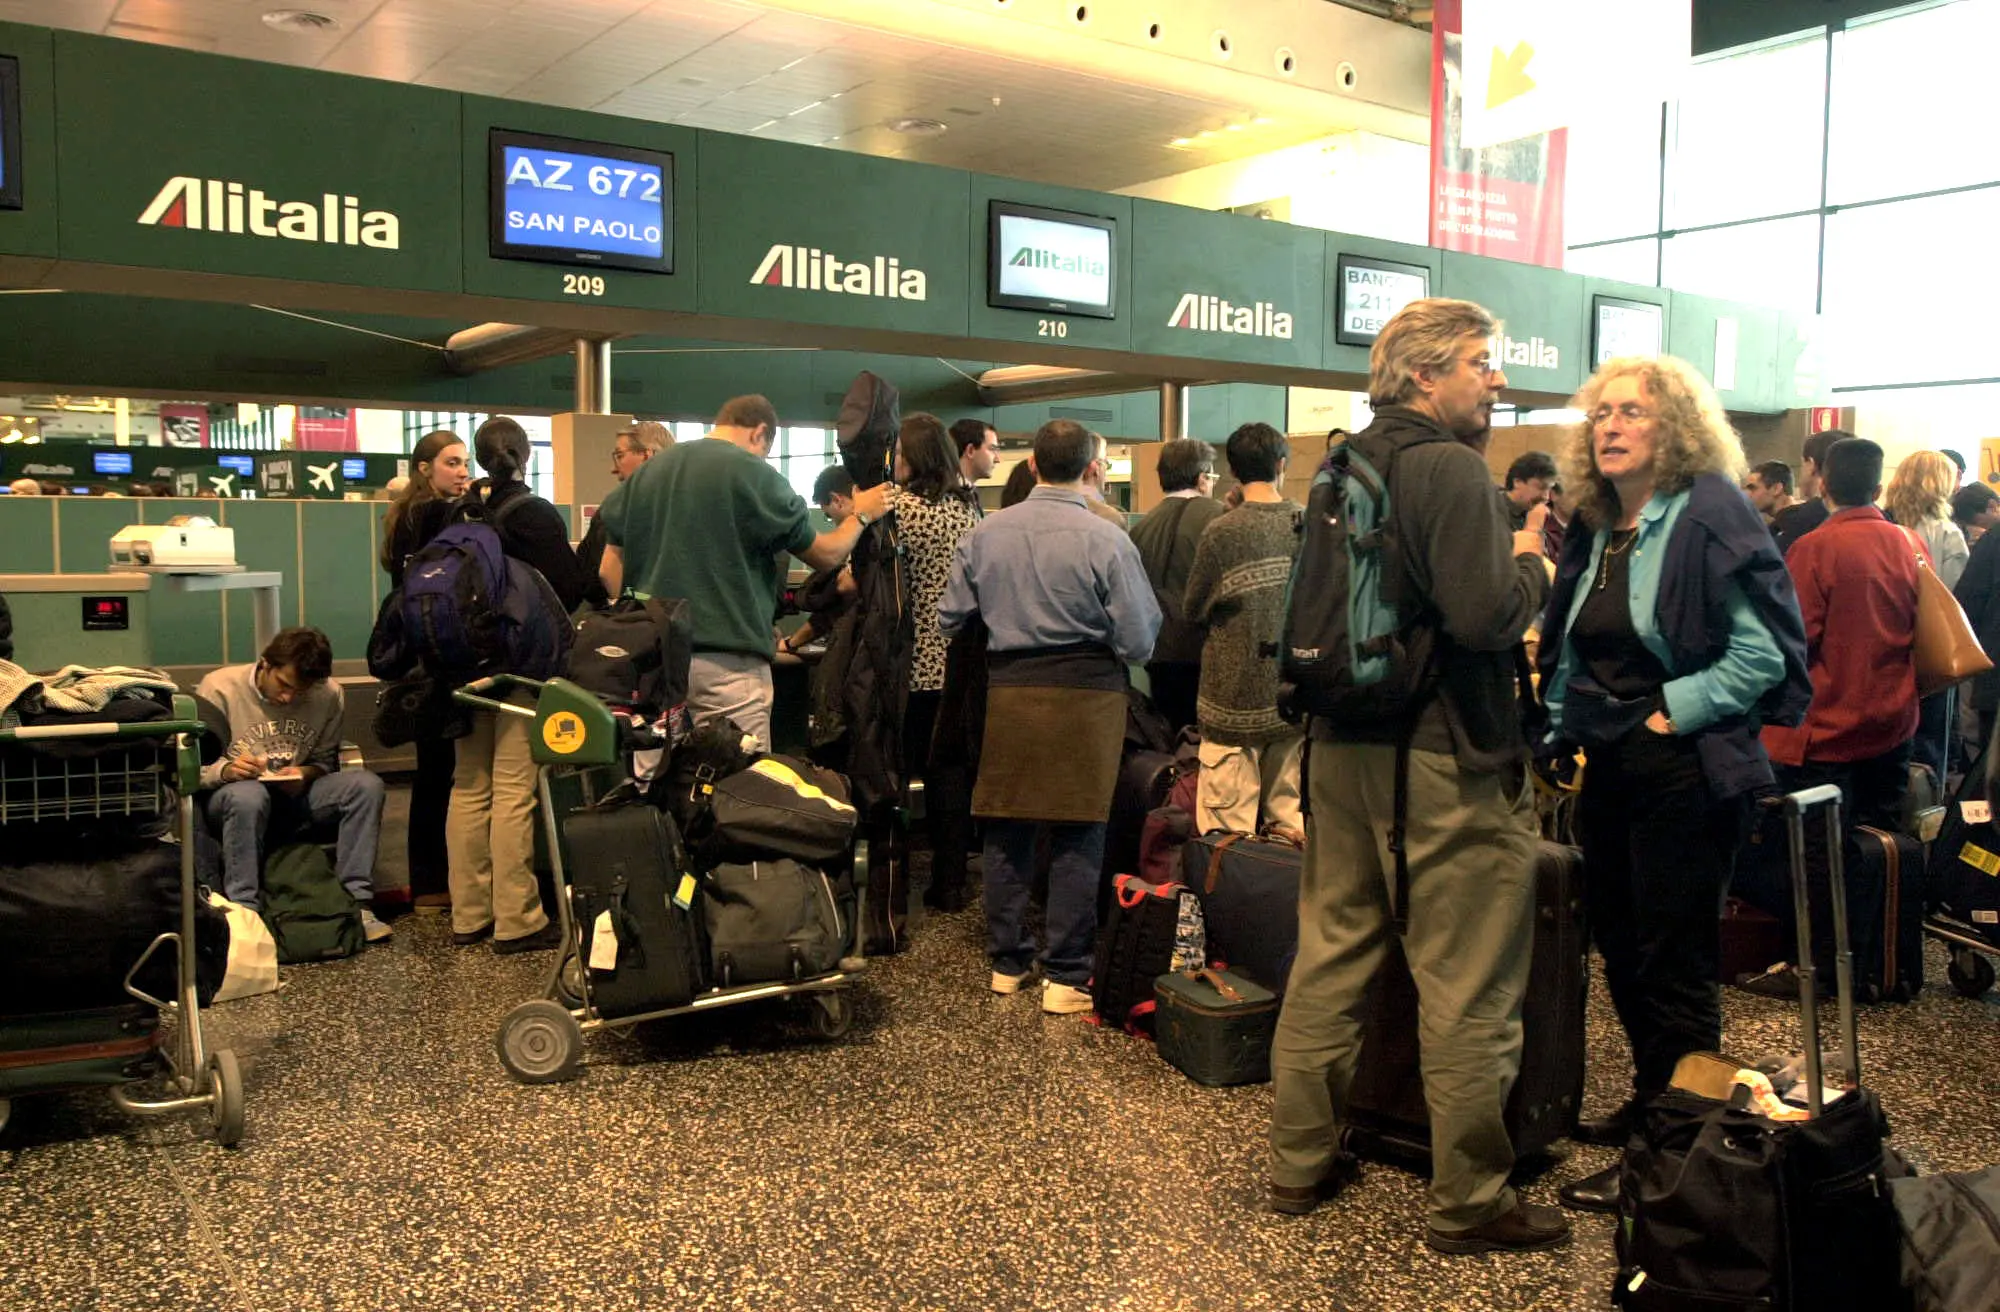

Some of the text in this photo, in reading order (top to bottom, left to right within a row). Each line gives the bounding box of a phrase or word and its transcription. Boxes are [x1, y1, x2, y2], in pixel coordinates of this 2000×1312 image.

[506, 156, 661, 203] AZ 672
[137, 176, 398, 249] Alitalia
[508, 211, 660, 243] SAN PAOLO
[749, 244, 926, 301] Alitalia
[1008, 247, 1104, 276] Alitalia
[563, 274, 605, 296] 209
[1347, 270, 1402, 288] BANC
[1167, 293, 1292, 339] Alitalia
[1359, 292, 1392, 313] 211
[1038, 319, 1067, 337] 210
[1488, 333, 1558, 369] litalia
